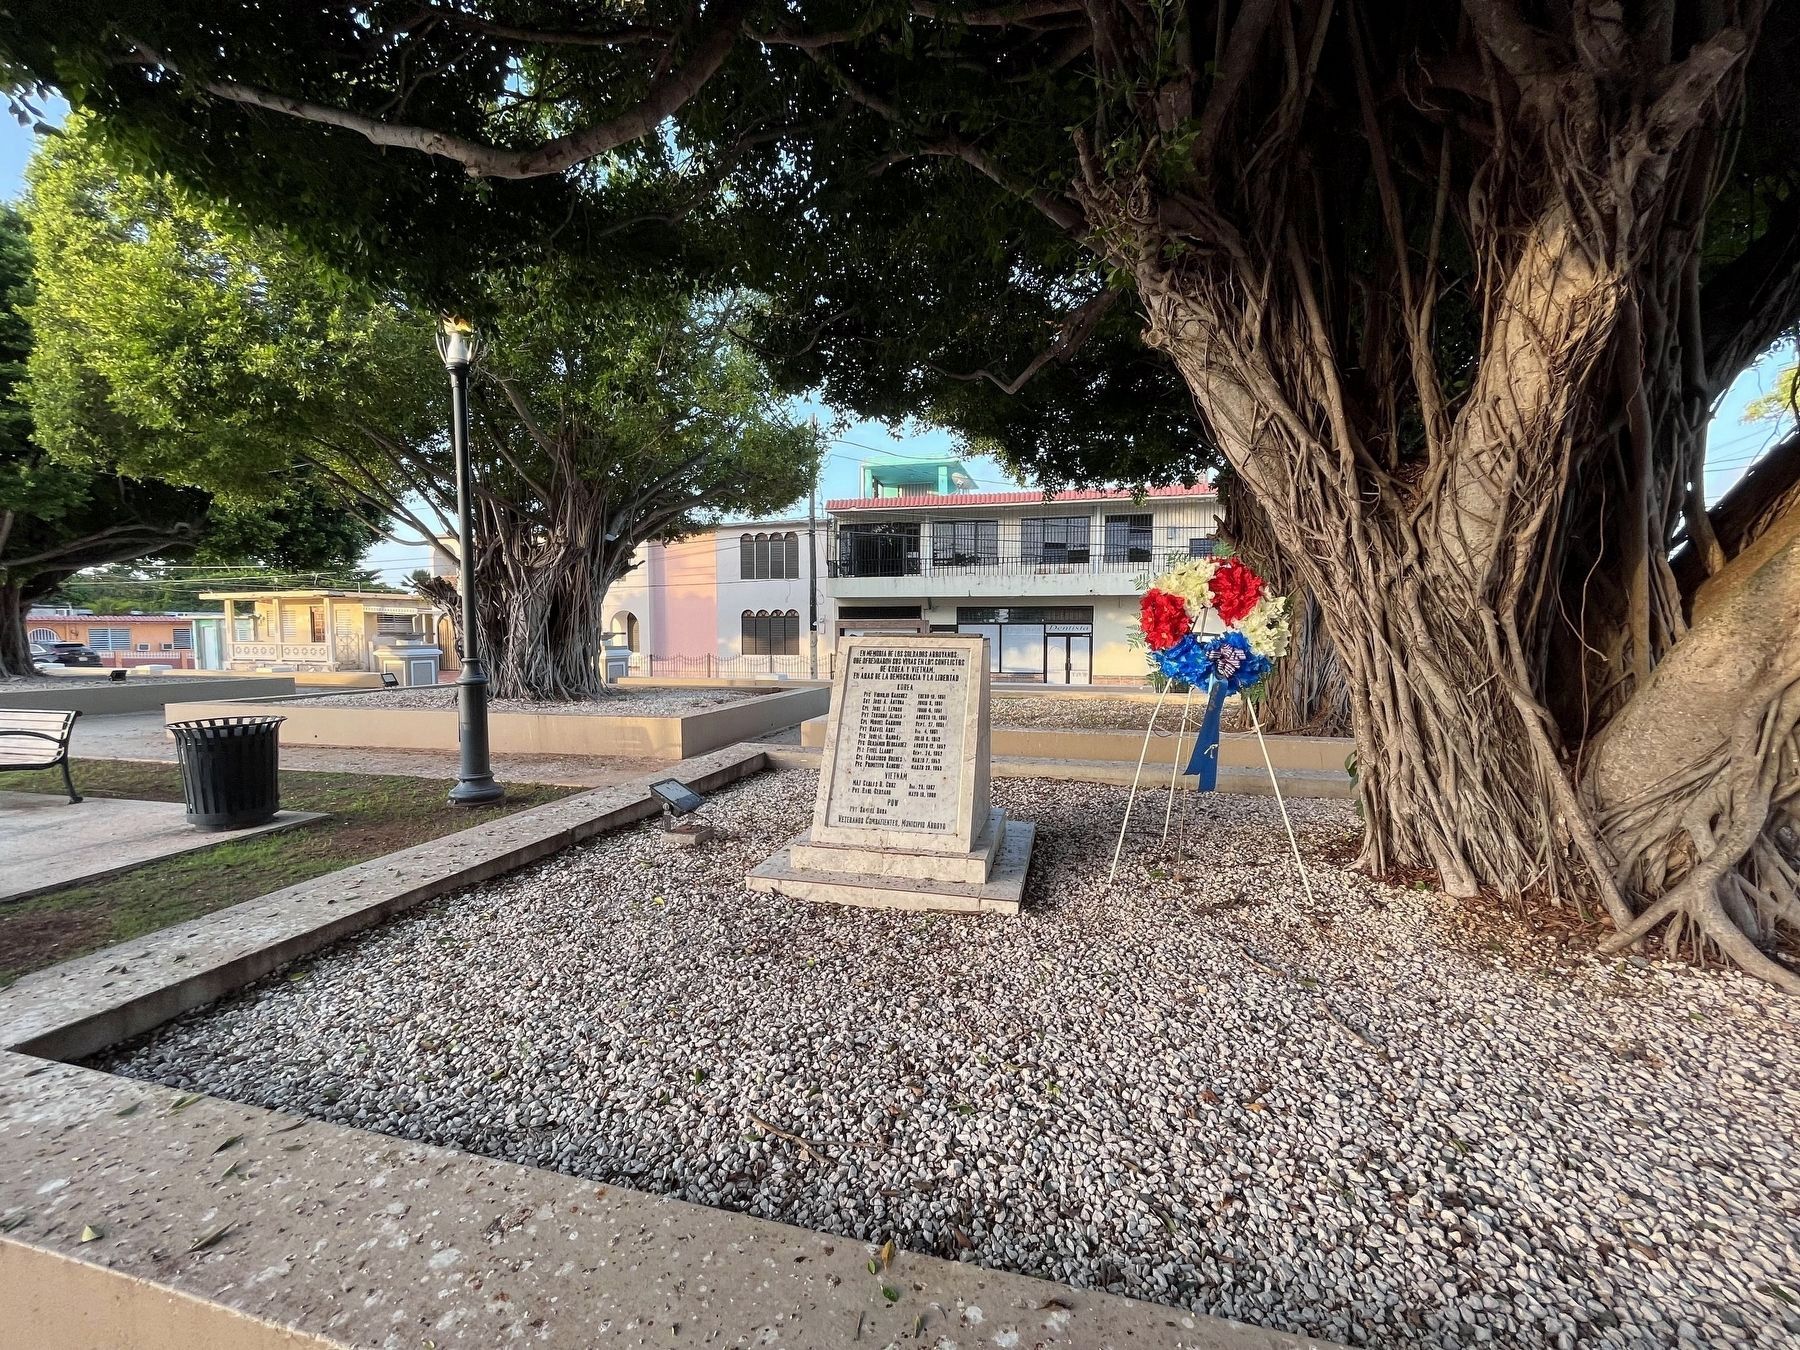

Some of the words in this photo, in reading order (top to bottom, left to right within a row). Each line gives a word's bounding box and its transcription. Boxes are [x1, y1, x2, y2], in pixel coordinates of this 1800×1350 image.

[839, 815, 864, 824] VETERANOS
[902, 819, 925, 828] MUNICIPIO
[927, 821, 946, 829] ARROYO
